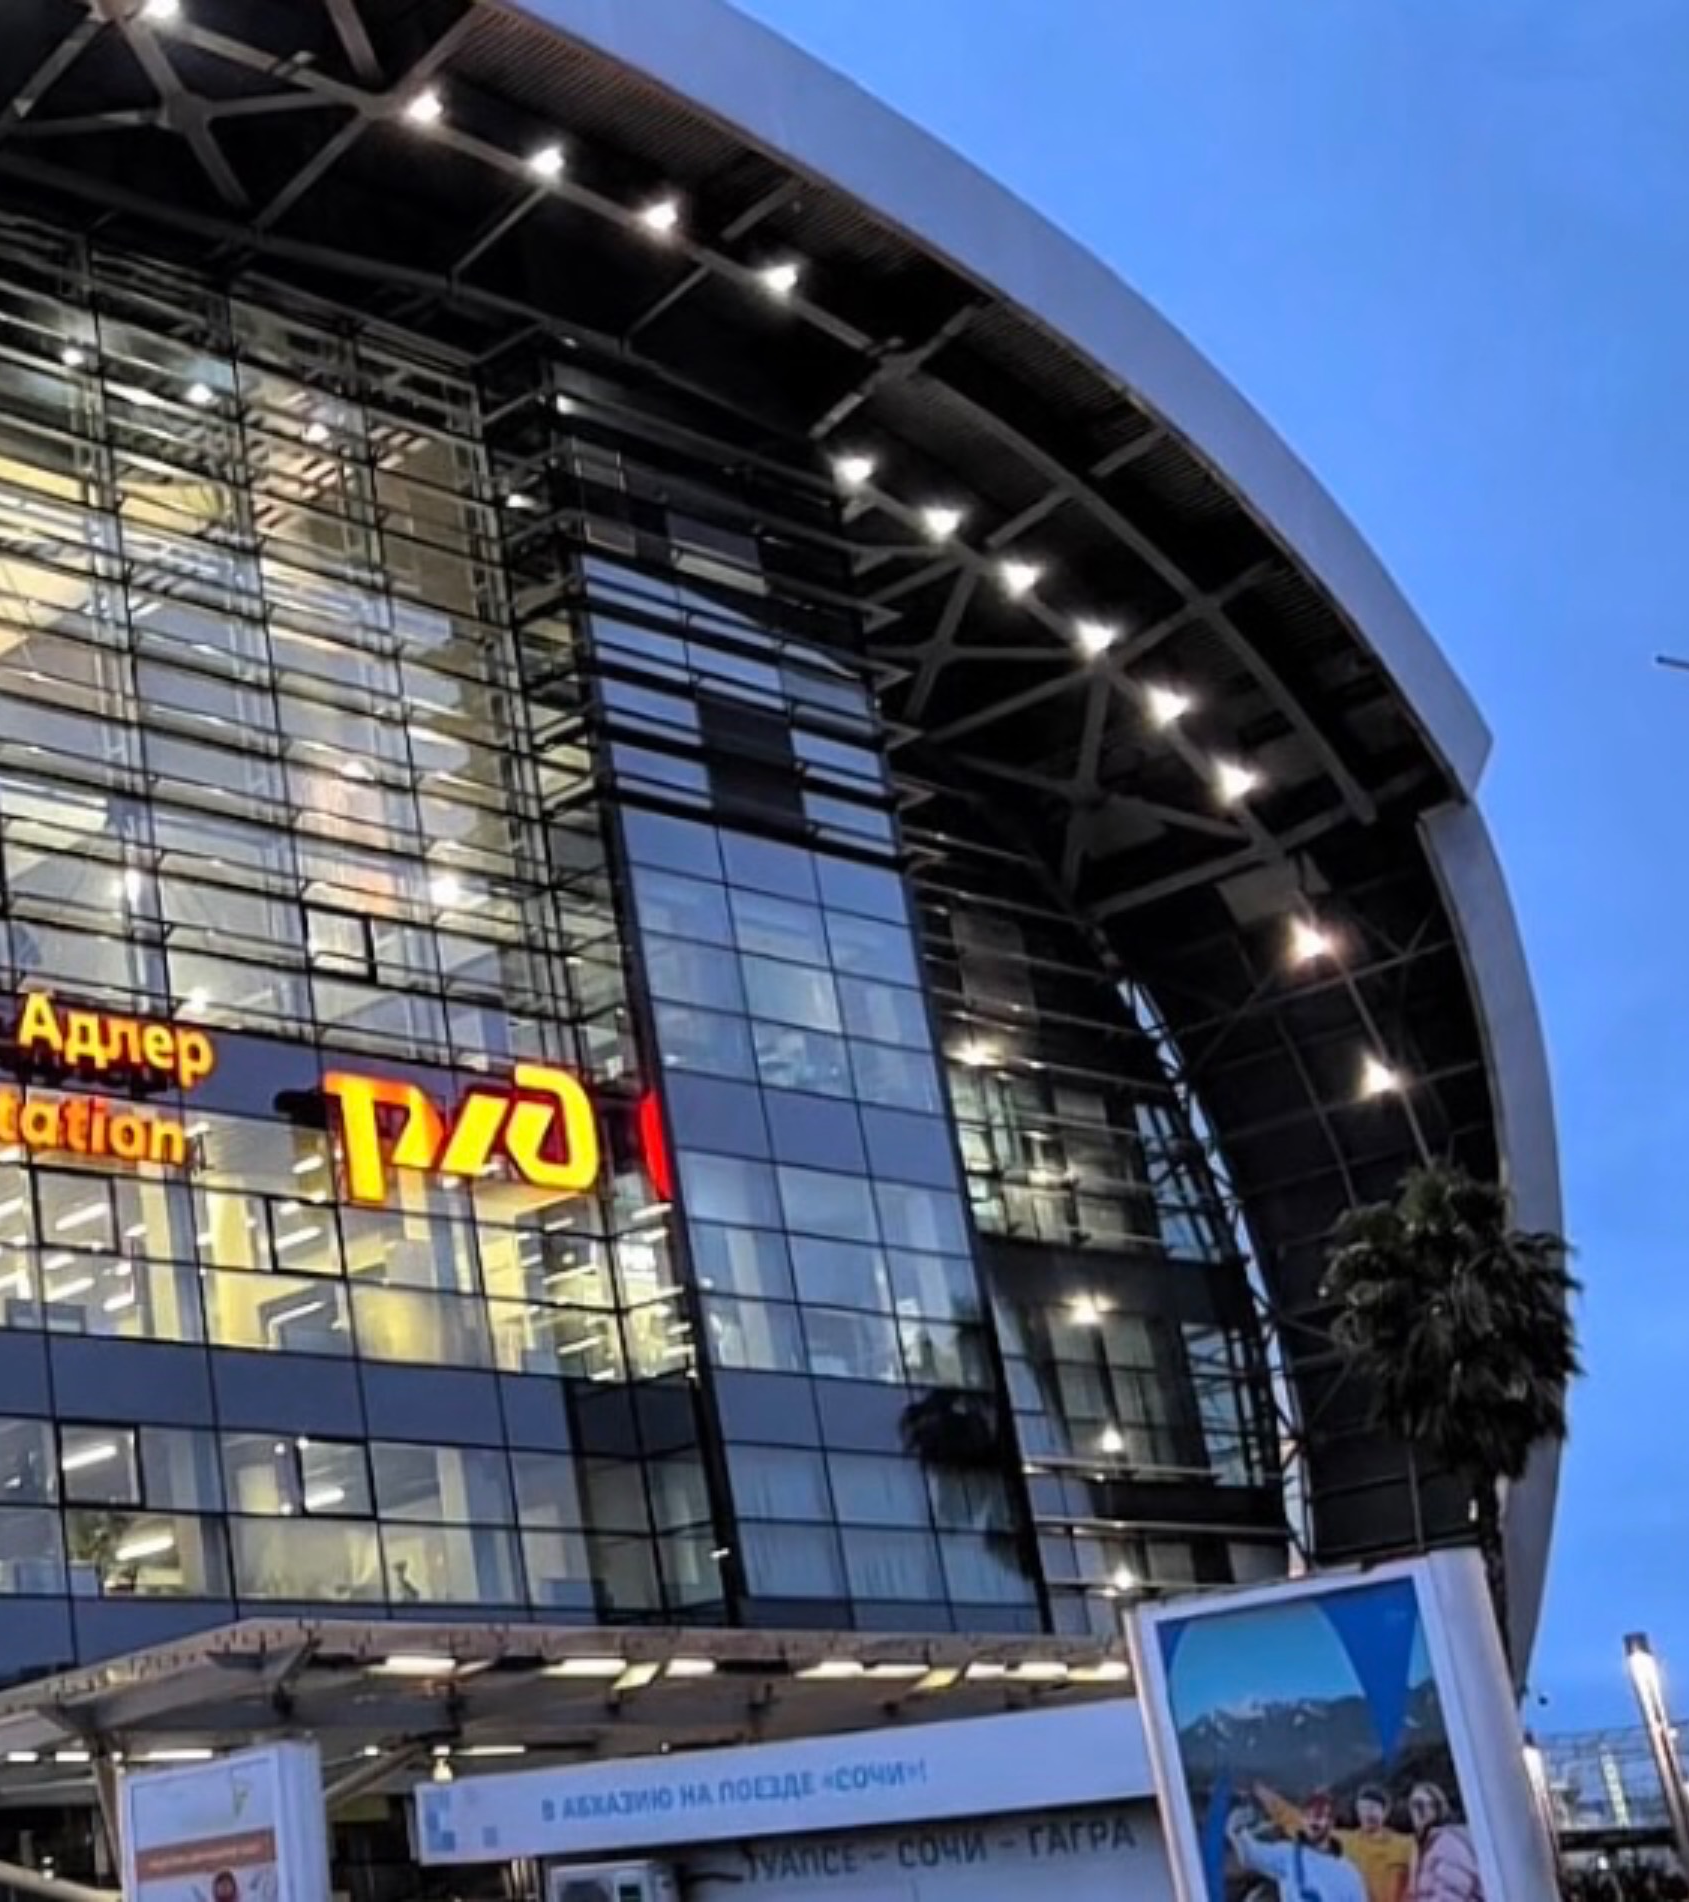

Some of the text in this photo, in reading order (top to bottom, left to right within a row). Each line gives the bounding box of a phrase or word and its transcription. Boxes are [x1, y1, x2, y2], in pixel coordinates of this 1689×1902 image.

[19, 990, 216, 1086] Адлер
[541, 1799, 555, 1822] В
[562, 1786, 672, 1820] АБХАЗИЮ
[679, 1783, 714, 1809] НА
[718, 1770, 815, 1806] ПОЕЗДЕ
[898, 1832, 989, 1868] СОЧИ
[1027, 1818, 1137, 1858] ГАГРА
